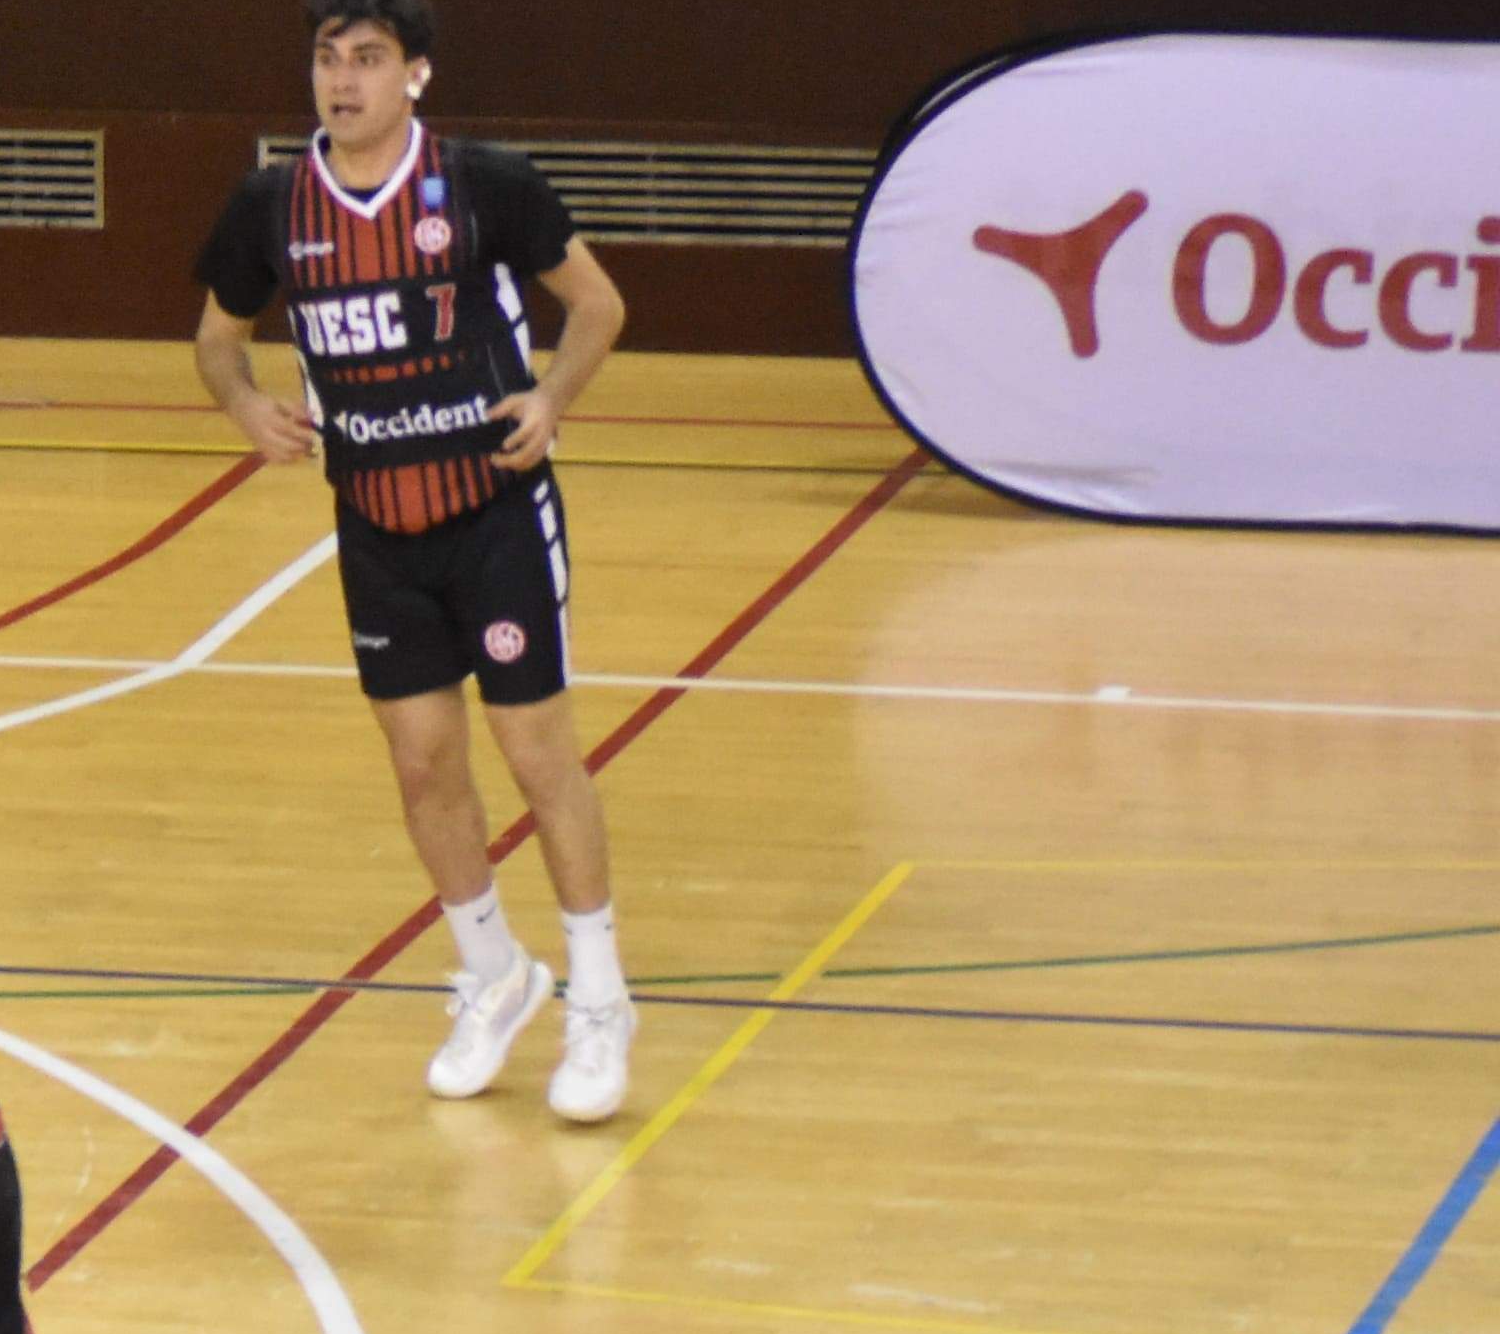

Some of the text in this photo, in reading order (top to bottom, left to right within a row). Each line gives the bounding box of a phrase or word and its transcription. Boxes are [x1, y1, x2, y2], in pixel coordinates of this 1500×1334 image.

[300, 282, 457, 356] UESC 7
[1172, 212, 1500, 353] Occi
[350, 395, 490, 445] Occident
